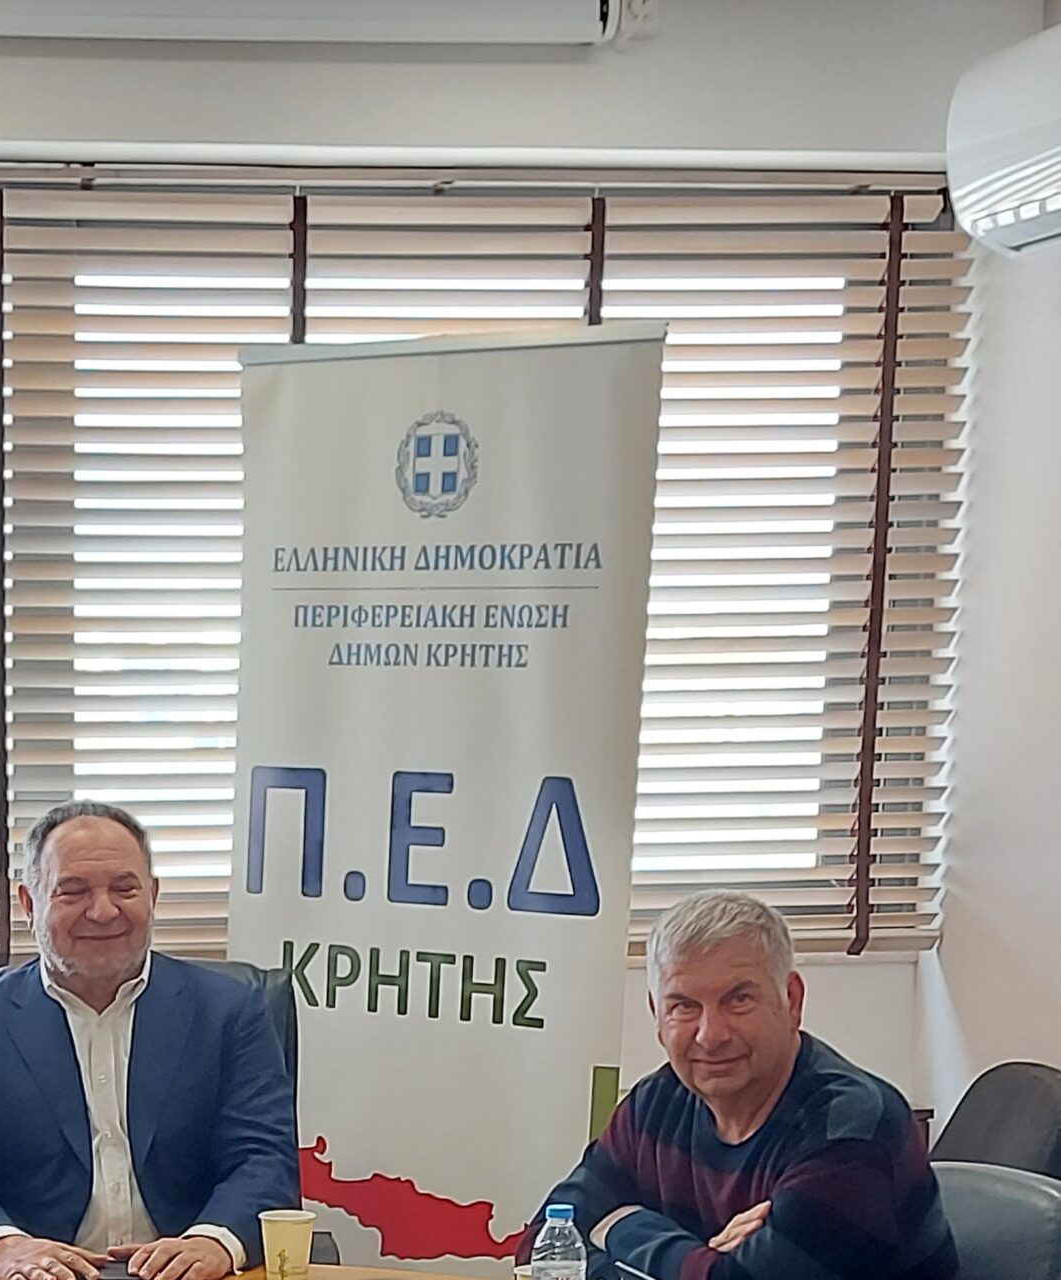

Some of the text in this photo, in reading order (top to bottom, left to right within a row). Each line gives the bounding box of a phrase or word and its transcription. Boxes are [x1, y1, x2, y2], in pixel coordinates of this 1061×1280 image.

[272, 542, 603, 572] ΕΛΛΗΝΙΚΗ ΔΗΜΟΚΡΑΤΙΑ
[293, 604, 569, 629] ΠΕΡΙΦΕΡΕΙΑΚΗ ΕΝΩΣΗ
[328, 643, 529, 668] ΔΗΜΩΝ ΚΡΗΤΗΣ
[246, 766, 600, 917] Π.Ε.Δ
[283, 940, 547, 1029] ΚΡΗΤΗΣ
